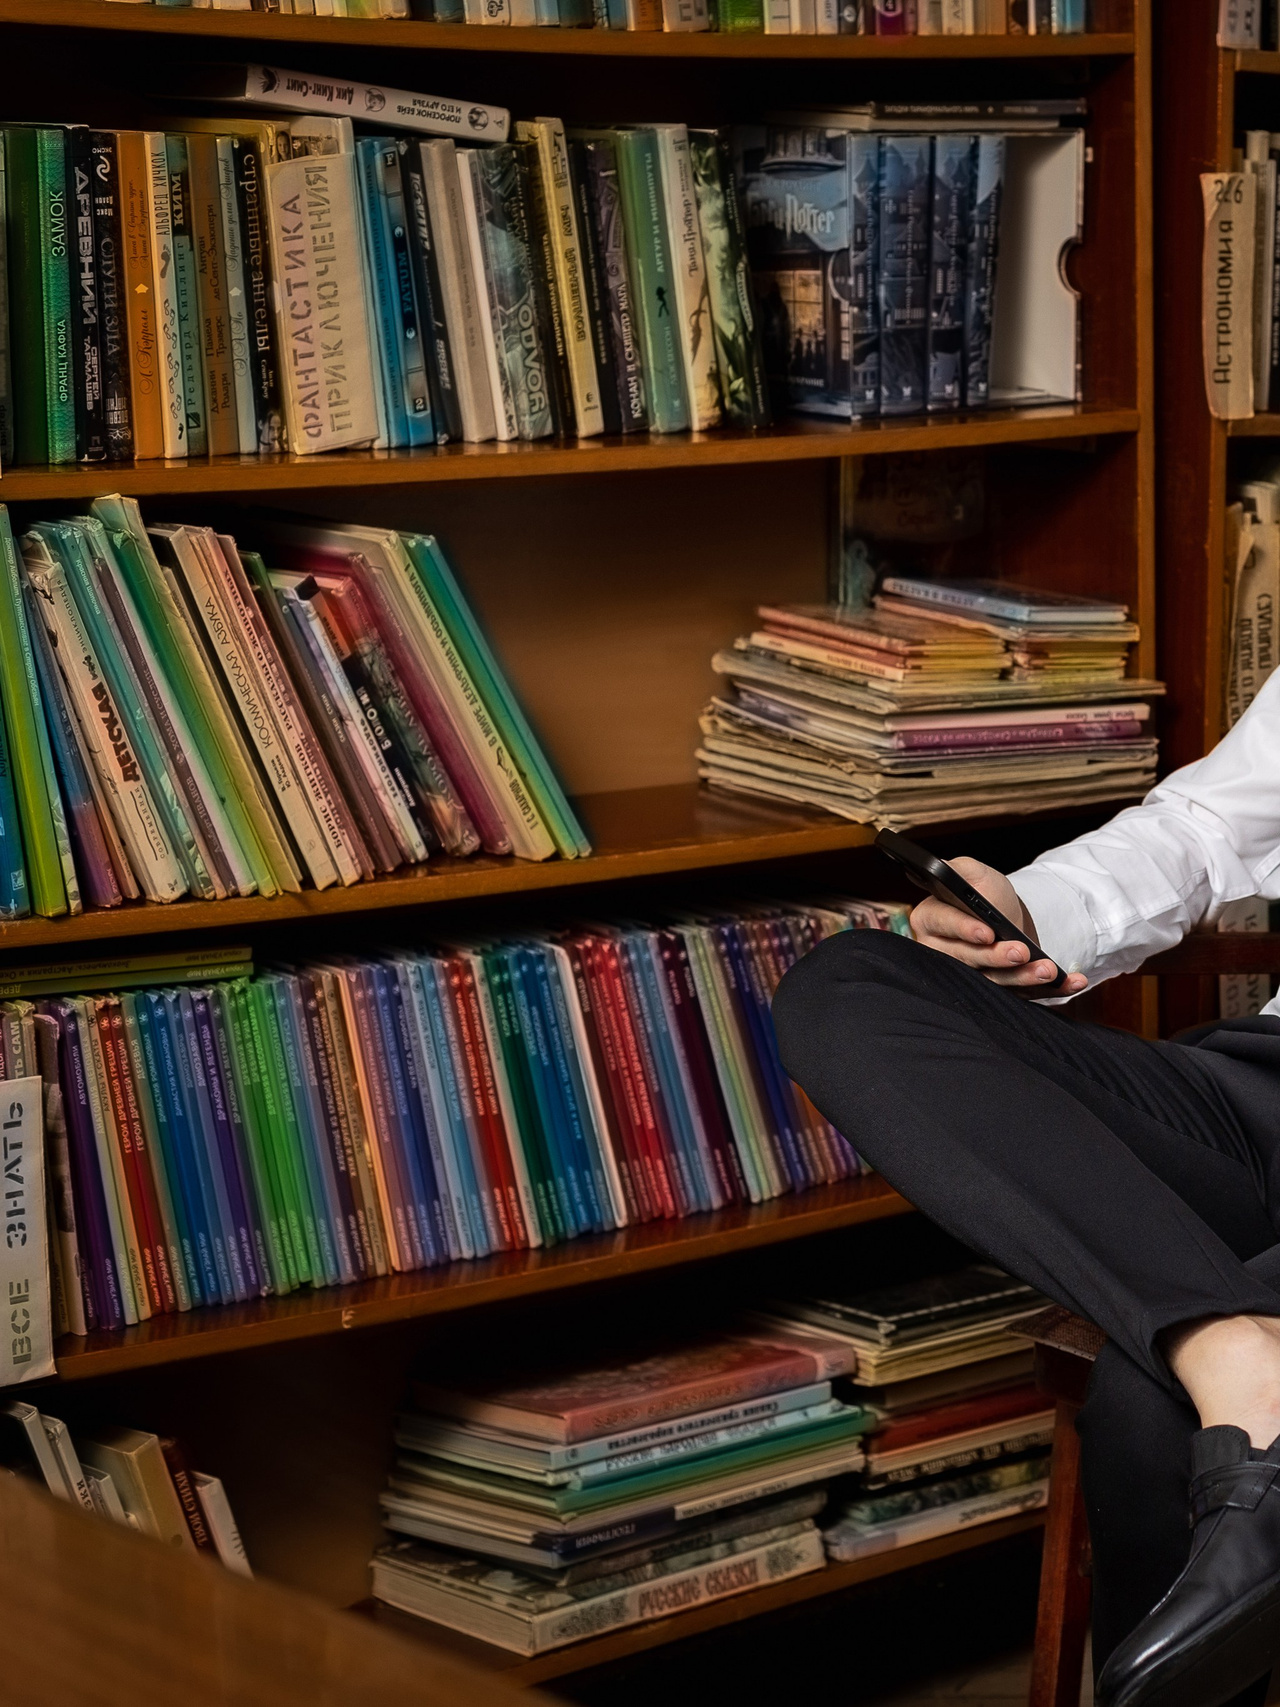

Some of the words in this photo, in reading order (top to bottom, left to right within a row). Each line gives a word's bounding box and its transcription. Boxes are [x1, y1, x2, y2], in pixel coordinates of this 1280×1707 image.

[286, 78, 334, 102] Кинг-Смит
[336, 86, 354, 105] Дик
[396, 104, 415, 116] БЕЙБ
[411, 98, 439, 110] ДРУЗЬЯ
[440, 103, 454, 113] ЕГО
[454, 106, 461, 114] И
[415, 108, 461, 123] ПОРОСЕНОК
[151, 151, 167, 187] ХИЧКОК
[385, 153, 394, 165] F
[170, 173, 185, 226] КИМ
[644, 151, 660, 222] МИНИПУТЫ
[50, 191, 67, 257] ЗАМОК
[154, 193, 171, 236] АЛЬФРЕД
[240, 154, 263, 266] странные
[560, 204, 573, 237] МЕЧ
[651, 224, 661, 235] И
[74, 166, 98, 324] ДРЕВНИЙ
[542, 233, 555, 280] ПЛАНЕТА
[652, 236, 665, 273] АРТУР
[99, 237, 118, 309] СЛУГИ
[176, 242, 190, 322] Киплинг
[250, 270, 271, 353] ангелы
[280, 193, 322, 438] ФАНТАСТИКА
[304, 165, 352, 432] ПРИКЛЮЧЕНИЯ
[1213, 219, 1234, 385] Астрономия
[56, 320, 68, 359] КАФКА
[104, 315, 120, 357] ЗЛА
[59, 361, 68, 402] ФРАНЦ
[83, 335, 94, 410] ТАРМАШЕВ
[90, 346, 100, 400] СЕРГЕЙ
[182, 328, 196, 406] Редьярд
[625, 363, 637, 374] И
[626, 375, 643, 419] КОНАН
[2, 536, 15, 564] Доктор
[74, 558, 90, 586] Красная
[85, 584, 101, 615] Шапочка
[407, 572, 443, 638] ОСЬМИНОГА
[53, 578, 89, 653] ЭНЦИКЛОПЕДИЯ
[201, 597, 231, 647] АЗБУКА
[23, 651, 36, 679] Страну
[439, 639, 449, 649] И
[29, 679, 40, 707] Обезьян
[141, 667, 164, 710] СУСЛИК
[223, 648, 276, 749] КОСМИЧЕСКАЯ
[259, 662, 294, 731] РАССКАЗЫ
[444, 648, 479, 707] ДЕЛЬФИНА
[90, 681, 141, 785] ДЕТСКАЯ
[162, 718, 181, 750] ХОМА
[472, 705, 494, 739] МИРЕ
[486, 735, 498, 747] В
[292, 741, 324, 802] ЖИТКОВ
[183, 775, 209, 818] ИВАНОВ
[133, 785, 166, 859] СОВРЕМЕННАЯ
[318, 804, 343, 849] БОРИС
[10, 1020, 21, 1055] САМ
[84, 1035, 95, 1083] ЧЕЛОВЕКА
[93, 1038, 103, 1069] СКАТЫ
[107, 1039, 118, 1078] ГРЕЦИИ
[119, 1037, 130, 1075] ГРЕЦИИ
[133, 1038, 145, 1080] ДЕРЕВЬЯ
[144, 1032, 158, 1081] РОМАНОВЫХ
[162, 1026, 175, 1076] РОМАНОВЫХ
[73, 1044, 87, 1105] АВТОМОБИЛИ
[170, 1075, 183, 1117] ДИНАСТИЯ
[92, 1085, 104, 1135] АНАТОМИЯ
[101, 1081, 110, 1112] АКУЛЫ
[114, 1078, 126, 1122] ДРЕВНЕЙ
[126, 1076, 139, 1120] ДРЕВНЕЙ
[154, 1081, 166, 1123] ДИНАСТИЯ
[122, 1122, 132, 1153] ГЕРОИ
[135, 1120, 144, 1151] ГЕРОИ
[3, 1101, 27, 1253] ЗНАТЬ
[108, 1273, 116, 1298] УЗНАЙ
[8, 1278, 32, 1365] ВСЕ
